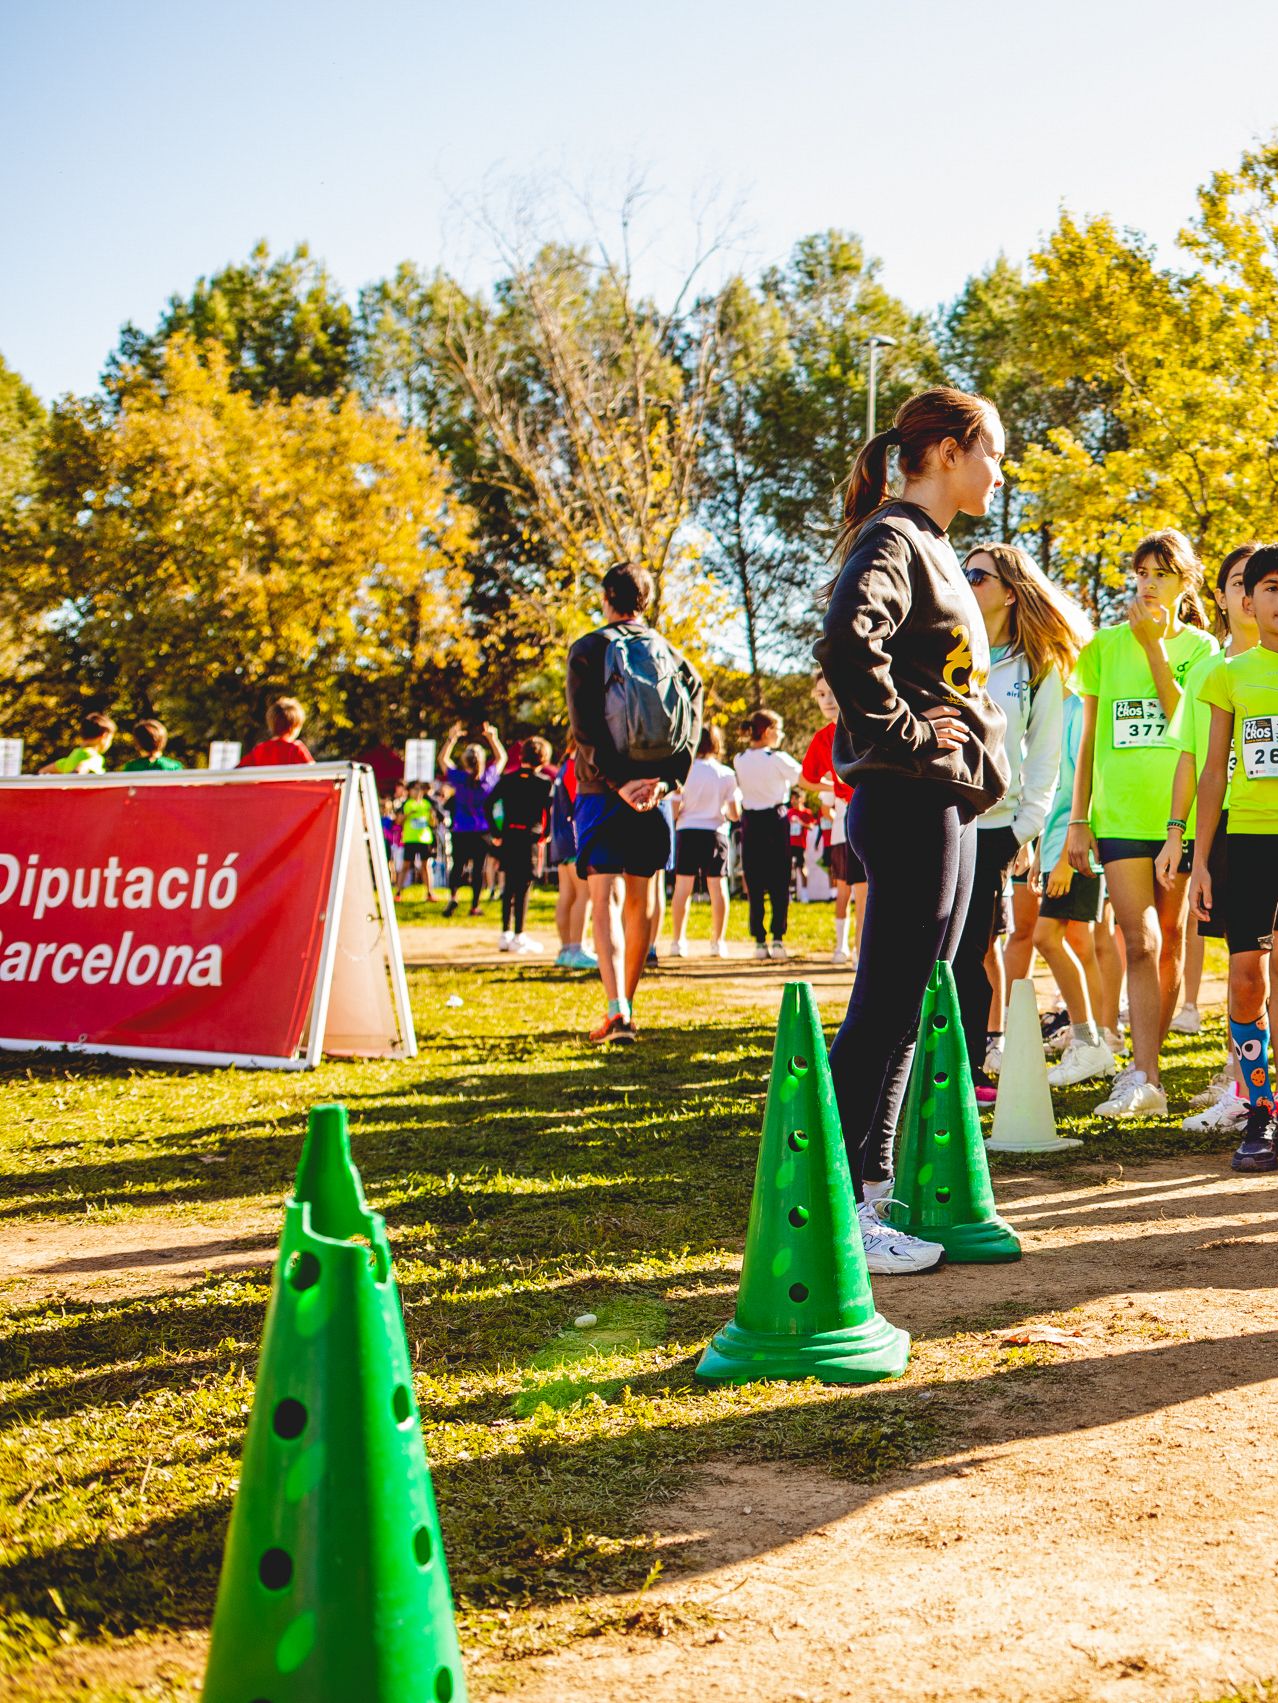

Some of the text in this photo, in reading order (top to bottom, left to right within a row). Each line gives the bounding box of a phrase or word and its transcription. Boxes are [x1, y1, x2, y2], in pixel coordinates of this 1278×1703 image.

[1129, 724, 1165, 737] 377
[1245, 728, 1271, 740] CROS
[0, 930, 223, 987] arcelona
